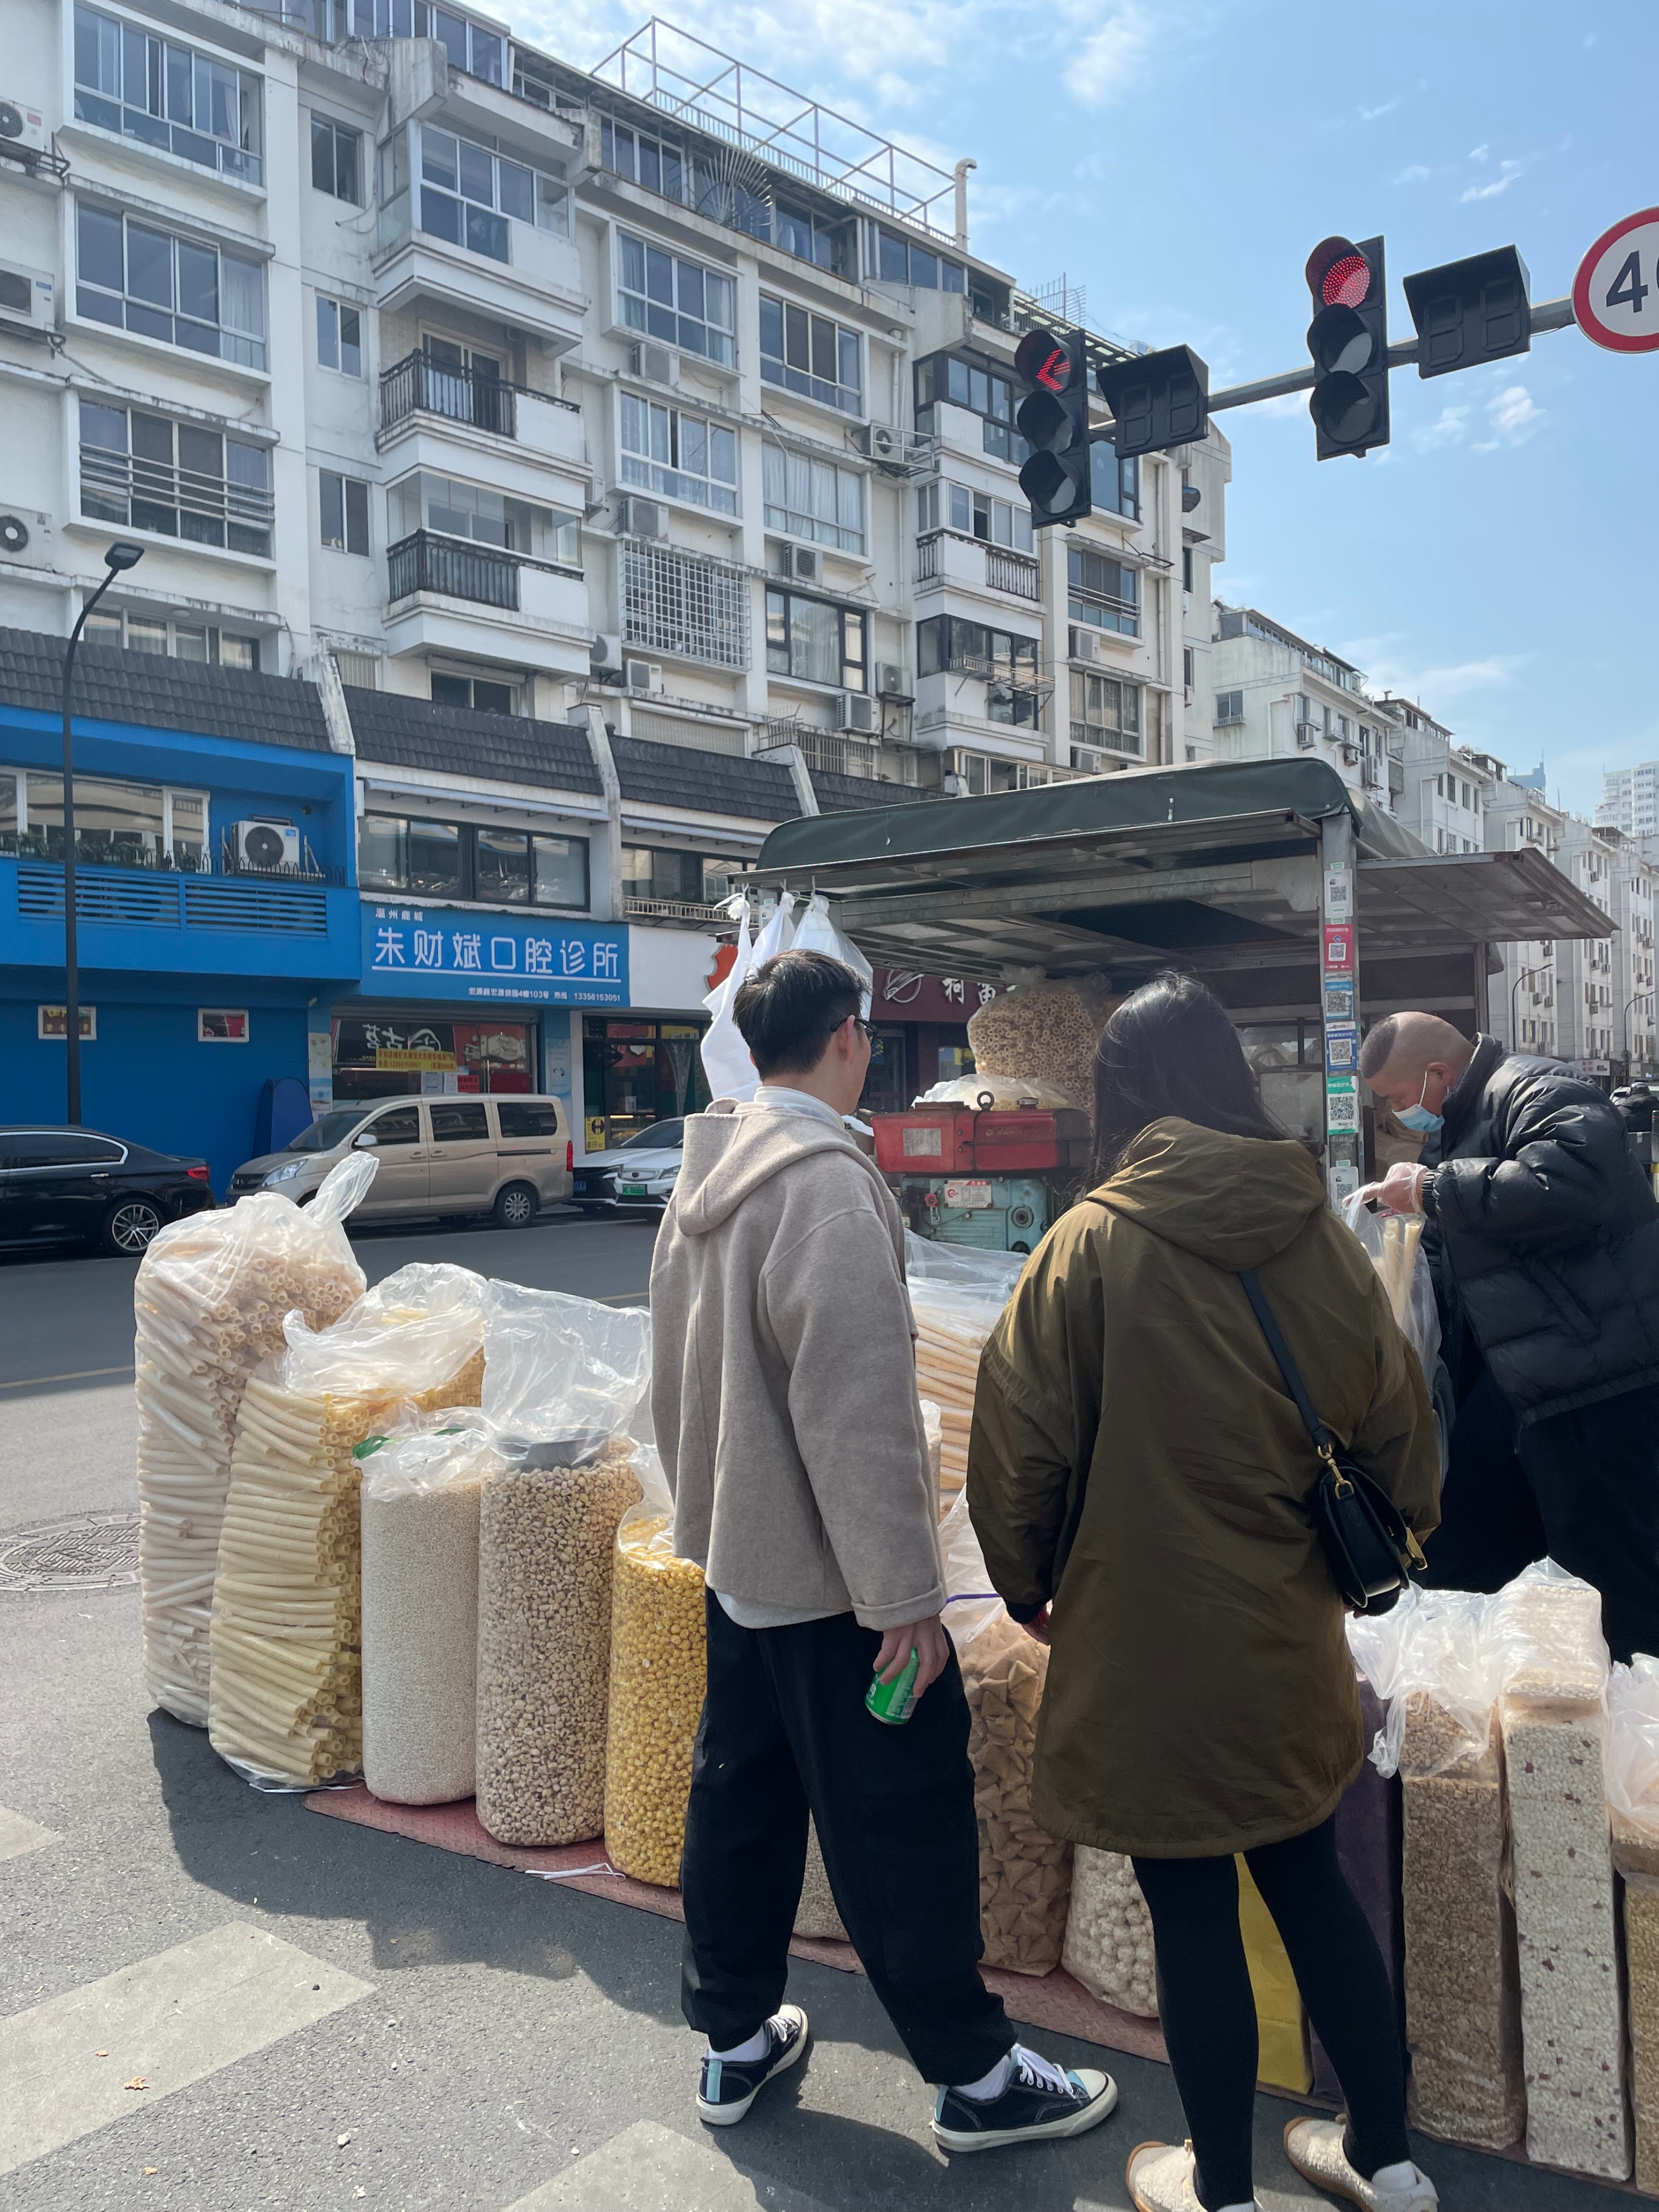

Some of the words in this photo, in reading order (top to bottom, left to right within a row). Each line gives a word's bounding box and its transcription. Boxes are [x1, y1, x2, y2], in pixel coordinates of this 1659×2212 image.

[1606, 250, 1659, 313] 4
[375, 907, 424, 922] 温州鹿城
[375, 926, 618, 978] 朱财斌口腔诊所
[573, 992, 621, 1002] 13356153051
